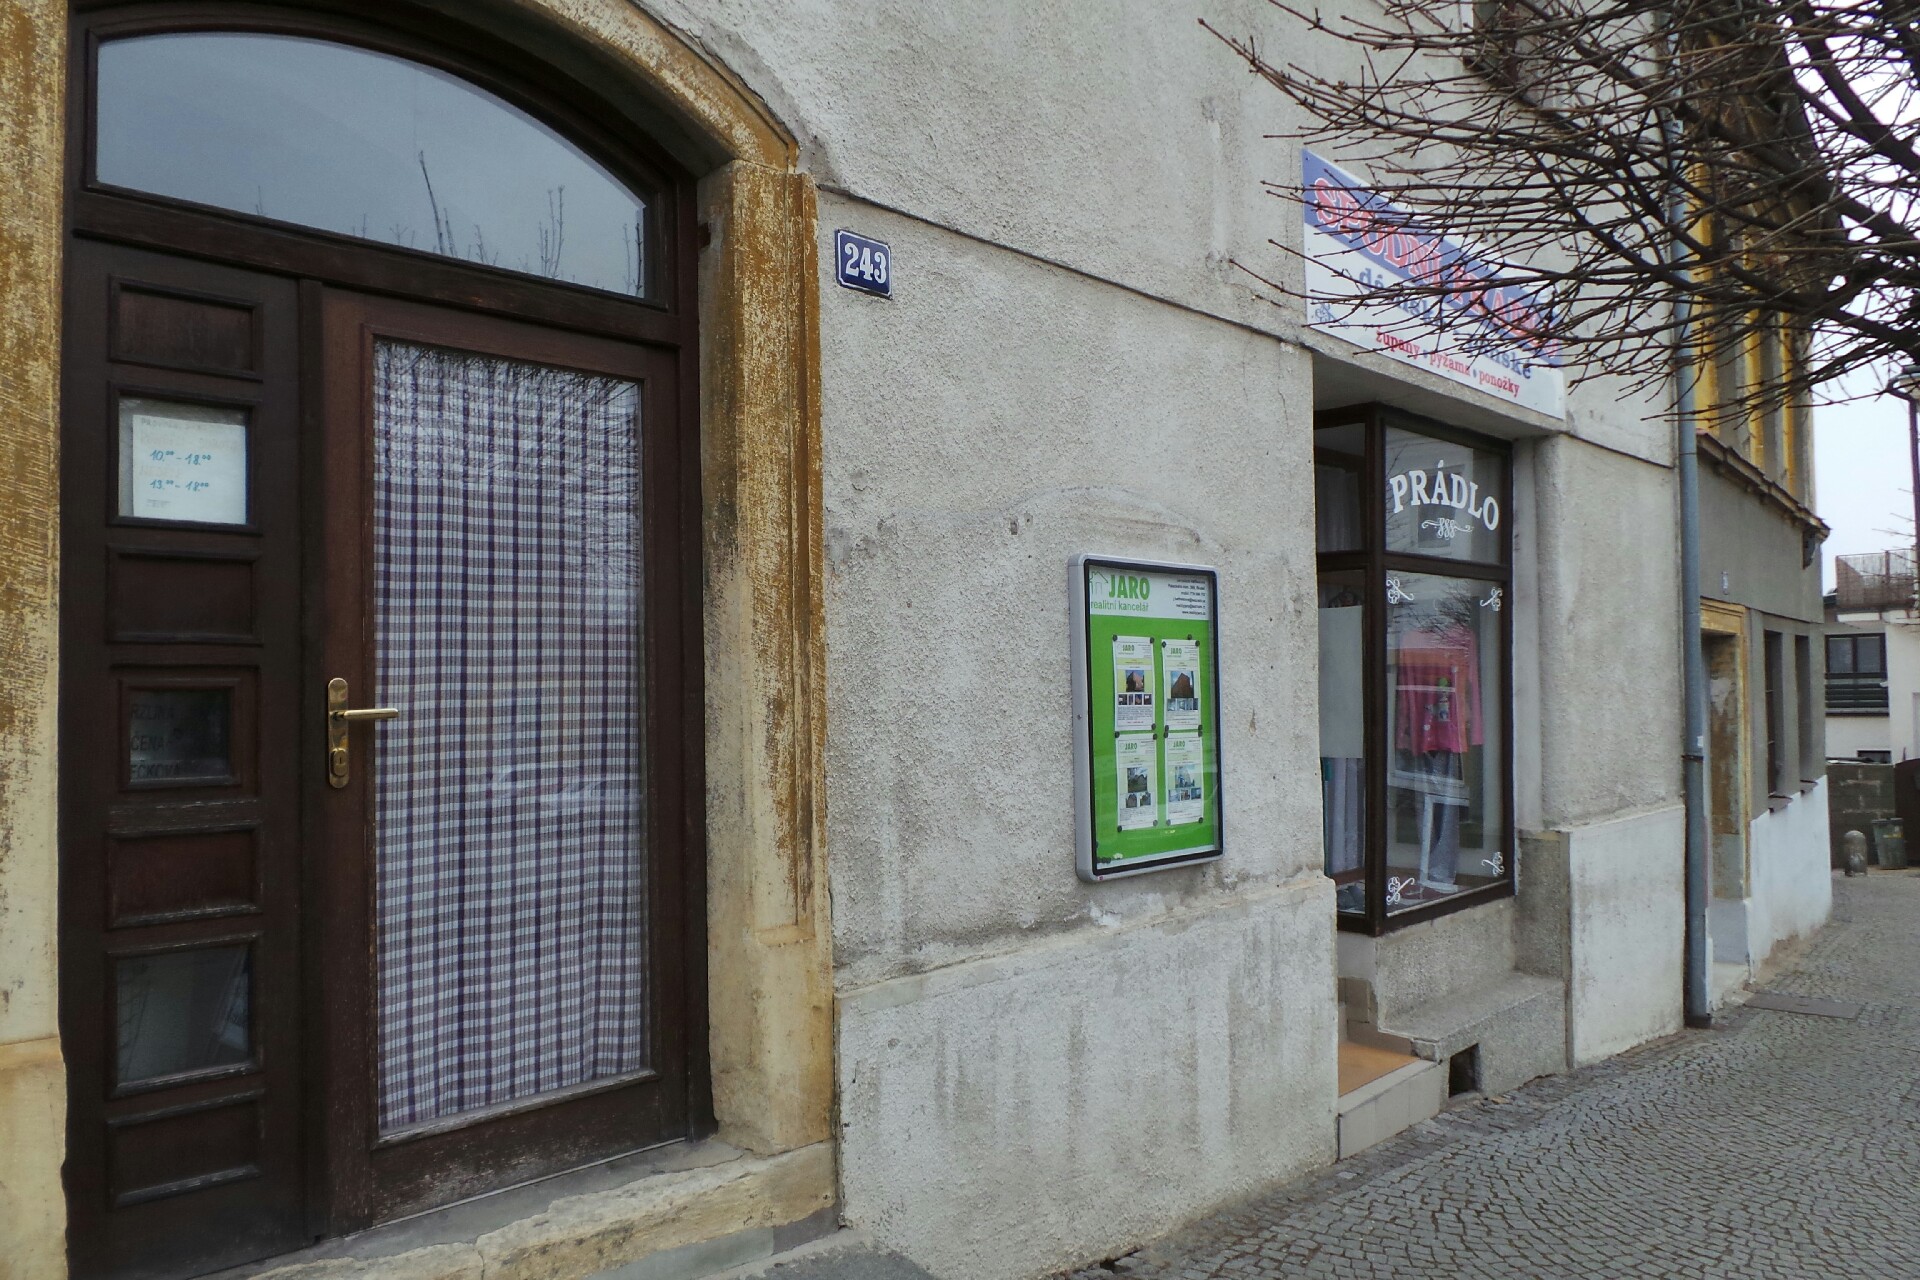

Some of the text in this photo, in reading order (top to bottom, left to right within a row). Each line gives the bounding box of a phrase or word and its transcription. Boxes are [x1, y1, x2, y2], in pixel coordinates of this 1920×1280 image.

[844, 242, 887, 284] 243
[1376, 326, 1520, 398] župany pyžama ponožky
[1389, 459, 1499, 531] PRÁDLO
[1108, 574, 1150, 600] JARO
